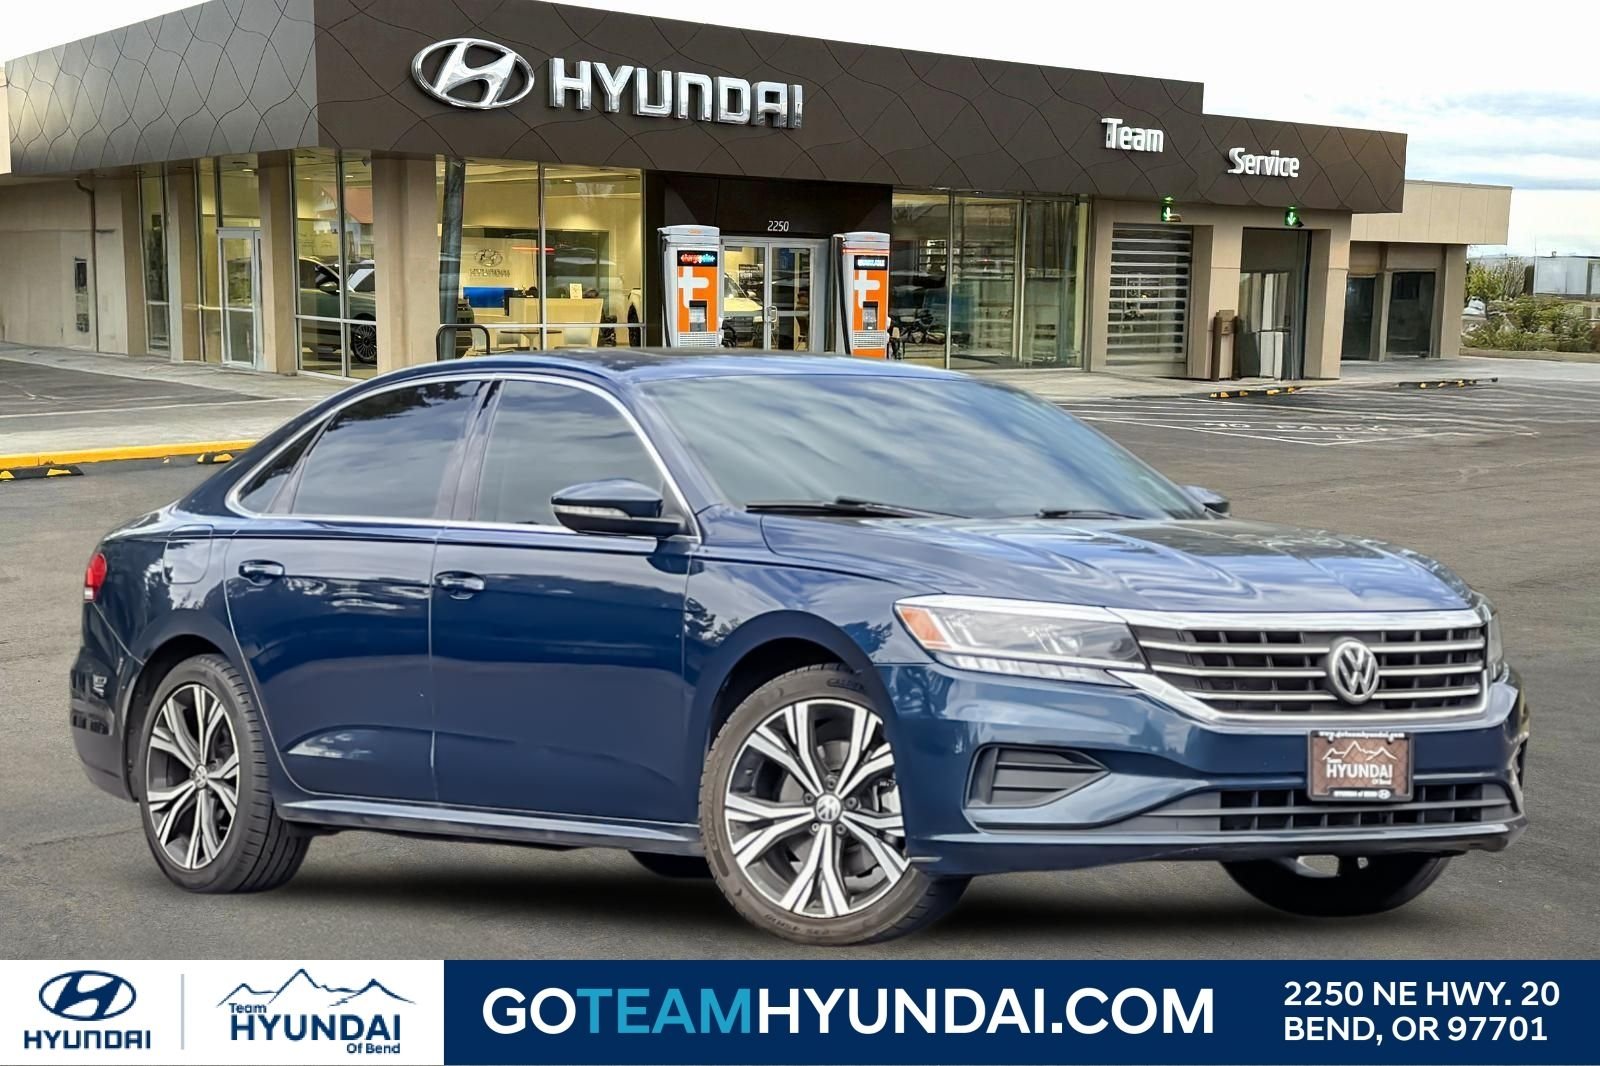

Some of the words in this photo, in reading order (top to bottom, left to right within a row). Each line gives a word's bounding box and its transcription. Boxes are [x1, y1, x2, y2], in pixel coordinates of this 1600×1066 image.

[549, 57, 804, 129] HYUNDAI
[1101, 117, 1165, 153] Team
[1227, 146, 1300, 178] Service
[767, 220, 790, 232] 2250
[1326, 764, 1394, 779] HYUNDAI
